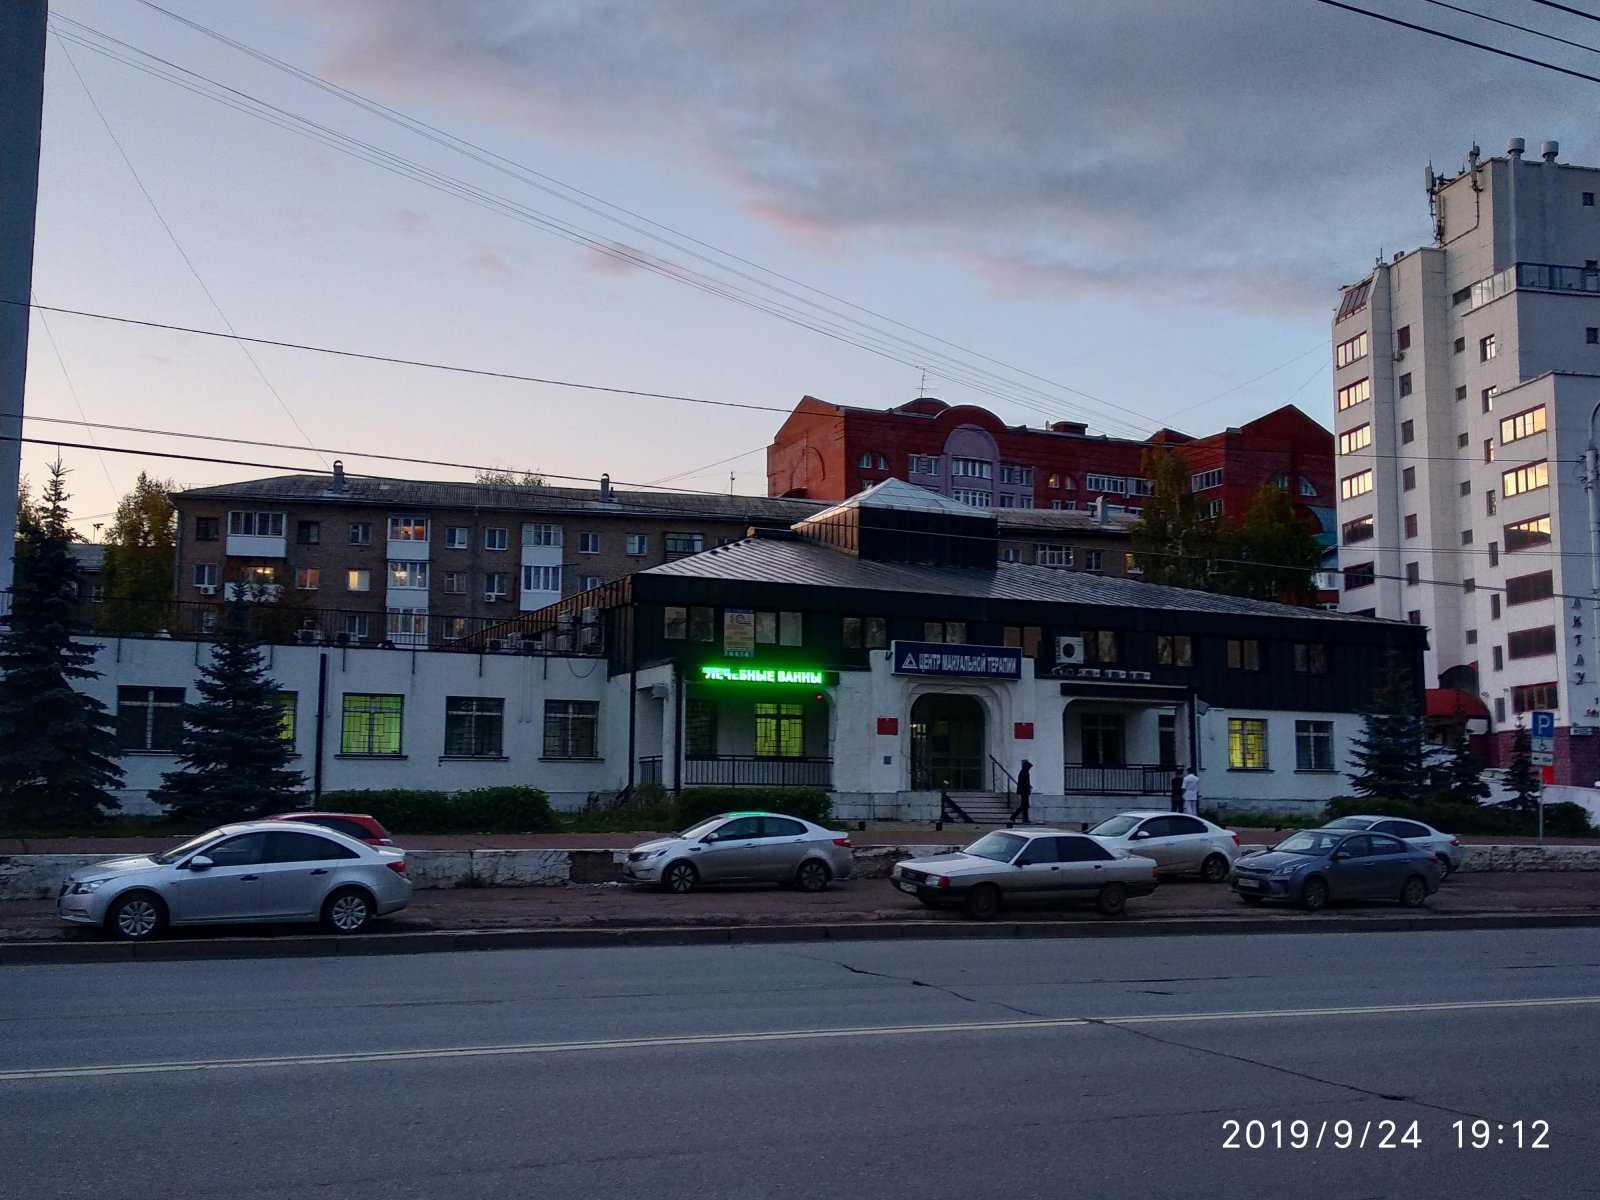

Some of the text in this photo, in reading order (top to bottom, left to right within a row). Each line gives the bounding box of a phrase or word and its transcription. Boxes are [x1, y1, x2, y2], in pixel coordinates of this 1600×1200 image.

[919, 653, 1017, 673] ЦЕНТР МАНУАЛЬНОЙ ТЕРАПИИ
[703, 667, 823, 684] ЛЕЧЕБНЫЕ ВАННЫ
